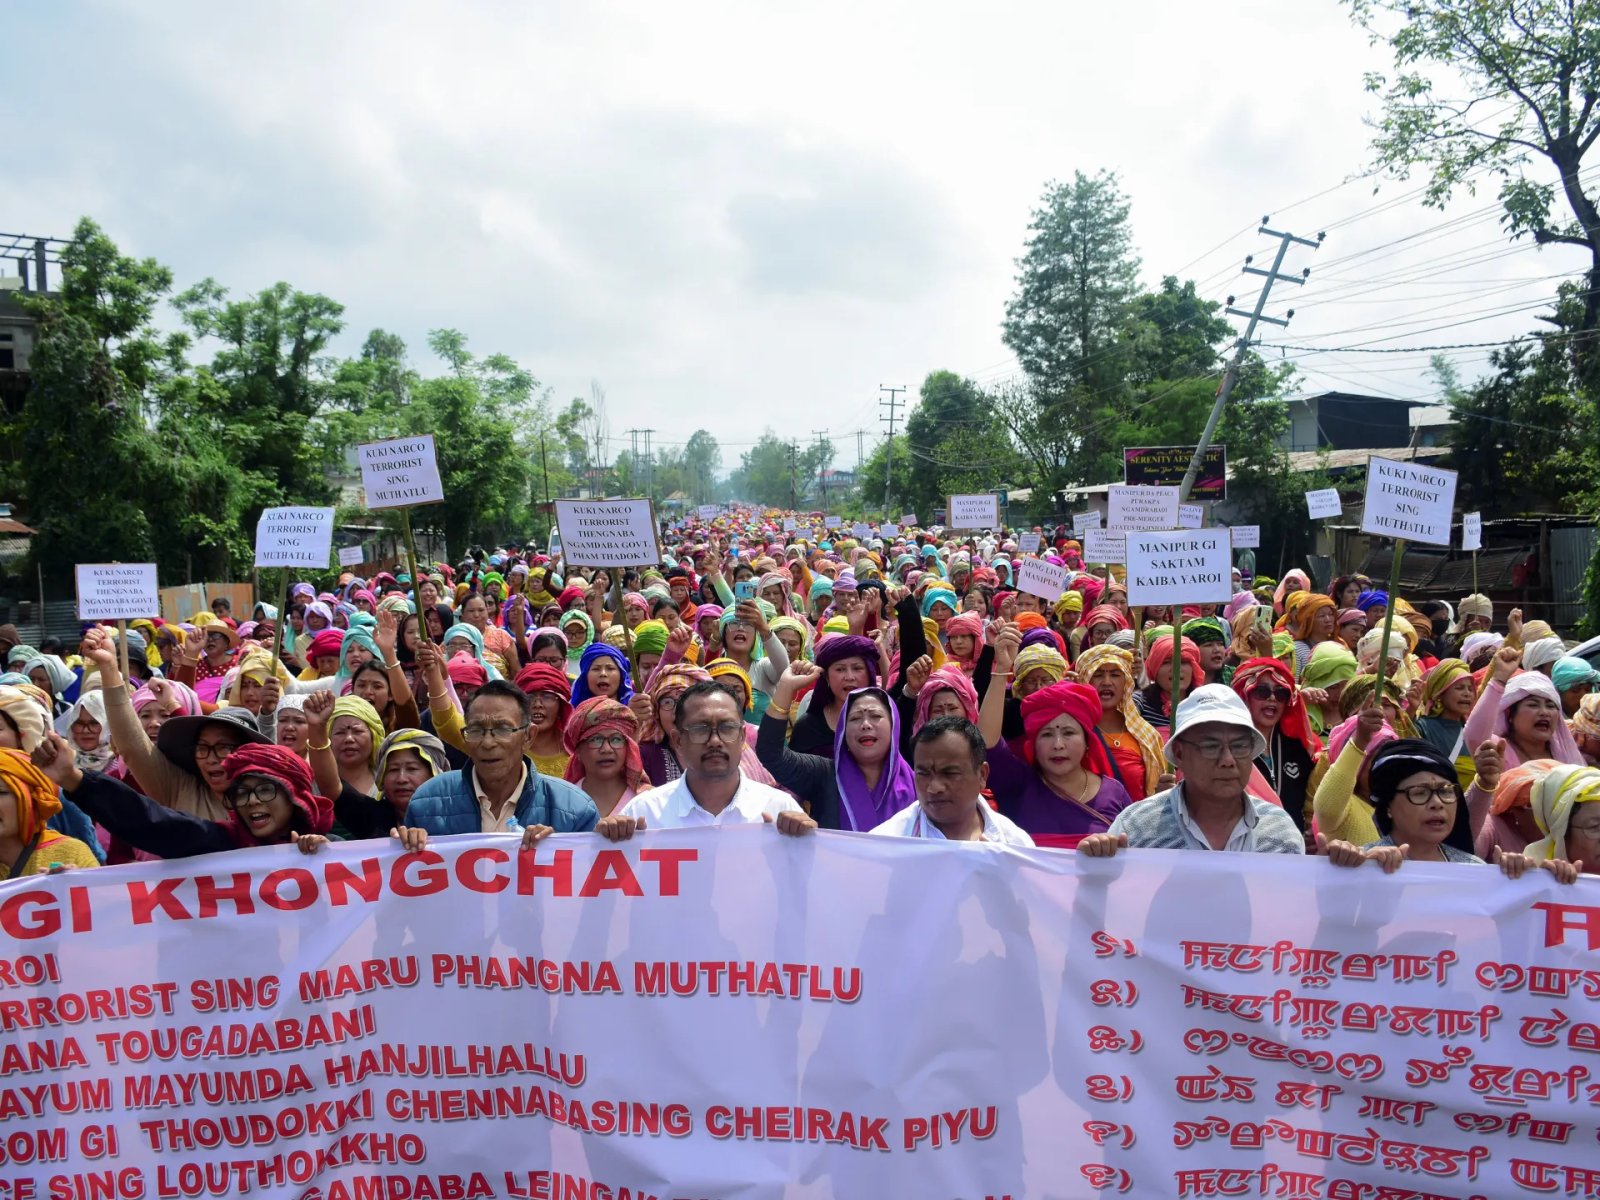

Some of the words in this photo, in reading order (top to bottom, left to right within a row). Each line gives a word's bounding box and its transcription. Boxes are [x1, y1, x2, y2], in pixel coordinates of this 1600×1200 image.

[366, 447, 387, 458] KUKI
[389, 443, 425, 455] NARCO
[371, 457, 424, 472] TERRORIST
[1172, 454, 1219, 462] AESTTIC
[387, 474, 409, 485] SING
[1379, 466, 1407, 479] KUKI
[1410, 471, 1446, 487] NARCO
[375, 486, 429, 500] MUTHATLU
[1381, 483, 1440, 503] TERRORIST
[573, 506, 596, 514] KUKI
[598, 506, 632, 514] NARCO
[1395, 502, 1419, 516] SING
[266, 512, 287, 521] KUKI
[290, 512, 324, 521] NARCO
[577, 518, 630, 526] TERRORIST
[267, 525, 318, 534] TERRORIST
[1374, 515, 1435, 536] MUTHATLU
[577, 530, 635, 538] THENGNABA
[277, 538, 300, 547] SING
[567, 541, 619, 549] NGAMDABA
[1139, 541, 1198, 553] MANIPUR
[1202, 540, 1217, 550] GI
[263, 551, 315, 561] MUTHATLU
[573, 552, 599, 560] PHAM
[601, 552, 641, 560] THADOK
[1151, 557, 1205, 569] SAKTAM
[1023, 559, 1044, 572] LONG
[1046, 567, 1062, 578] LIVE
[1024, 571, 1058, 588] MANIPUR
[1136, 575, 1177, 587] KAIBA
[1181, 573, 1221, 584] YAROI
[0, 890, 92, 939] GI
[127, 848, 698, 925] KHONGCHAT
[191, 975, 281, 1012] SING
[300, 955, 419, 1002] MARU
[432, 954, 622, 994] PHANGNA
[634, 960, 863, 1002] MUTHATLU
[97, 1005, 377, 1064] TOUGADABANI
[124, 1064, 314, 1109] MAYUMDA
[325, 1042, 587, 1087] HANJILHALLU
[80, 1124, 118, 1158] GI
[140, 1088, 374, 1152] THOUDOKKI
[386, 1086, 692, 1136] CHENNABASING
[705, 1105, 890, 1151] CHEIRAK
[904, 1105, 997, 1151] PIYU
[49, 1167, 144, 1200] SING
[157, 1132, 426, 1197] LOUTHOKKHO
